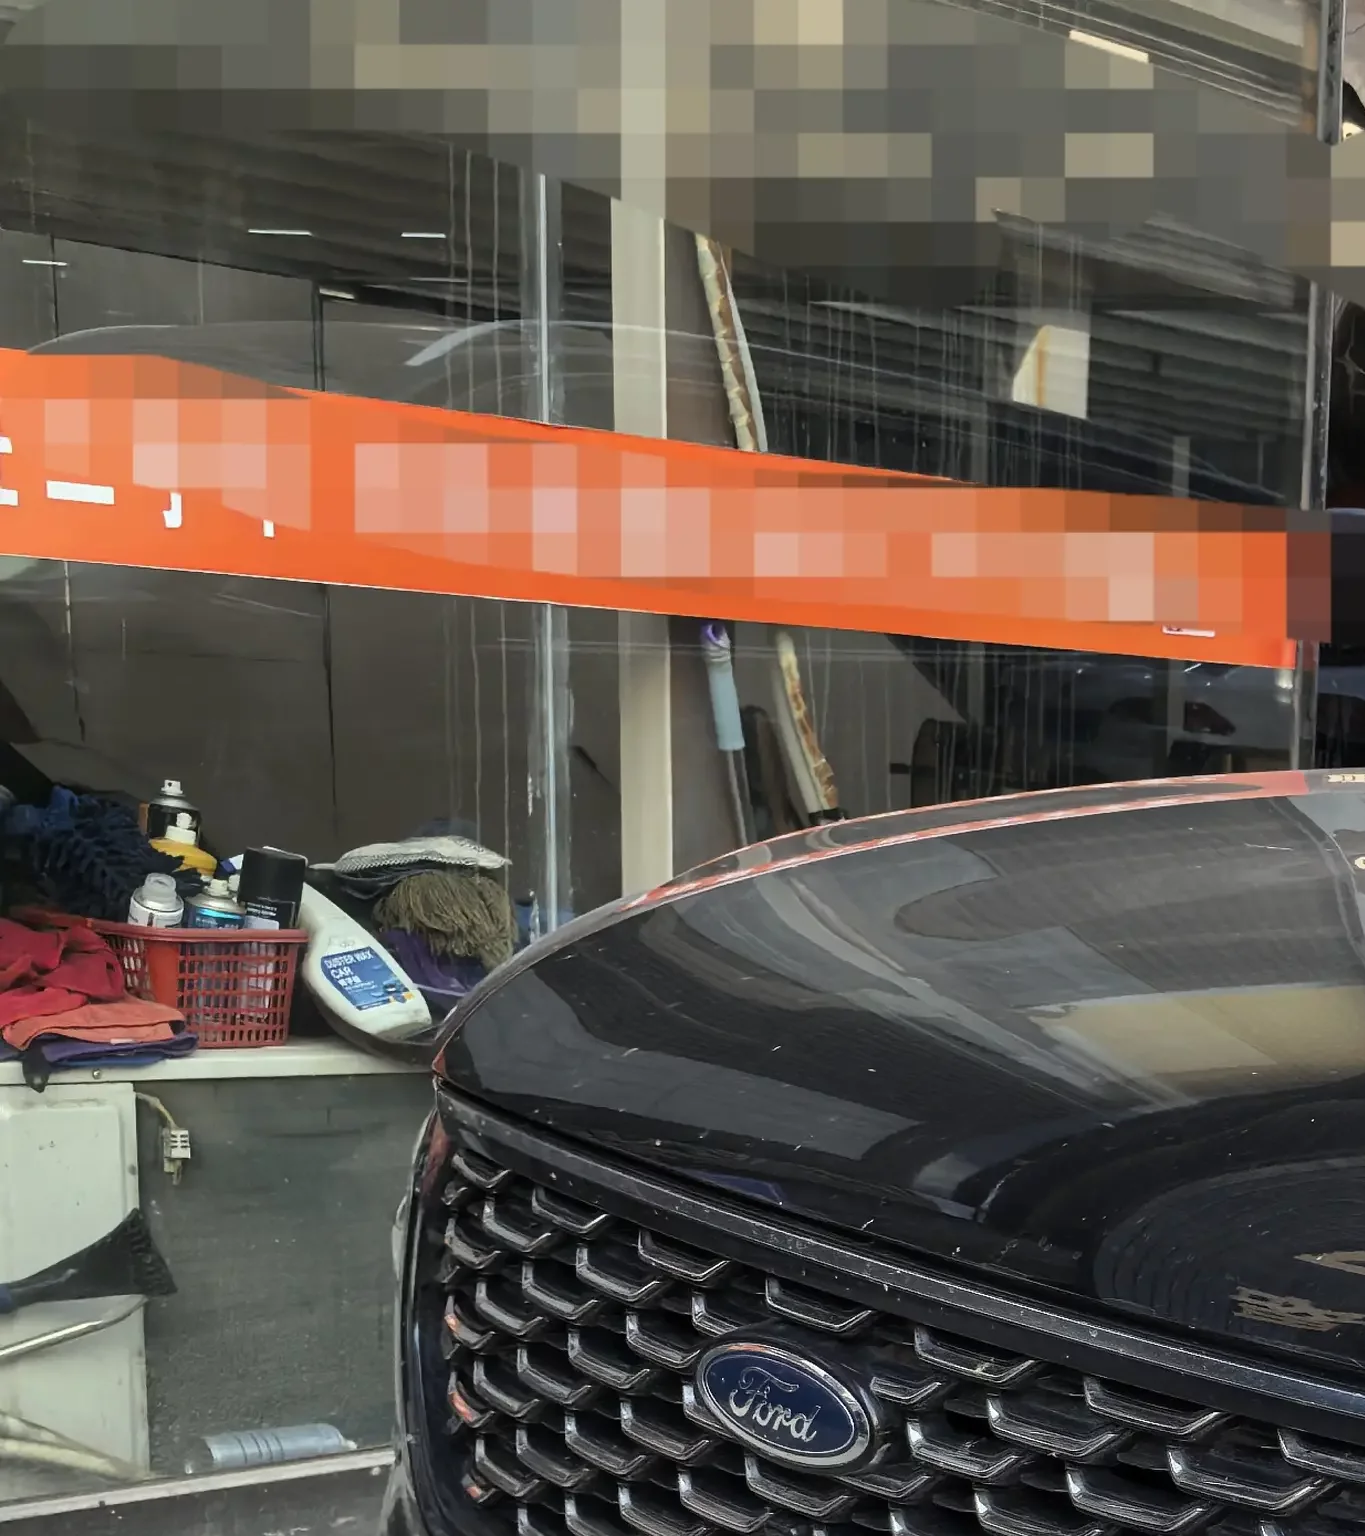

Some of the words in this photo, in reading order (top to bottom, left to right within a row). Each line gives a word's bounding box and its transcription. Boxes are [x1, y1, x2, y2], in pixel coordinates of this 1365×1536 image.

[324, 954, 356, 969] DUSTER
[330, 966, 354, 979] CAR
[729, 1367, 821, 1442] Ford
